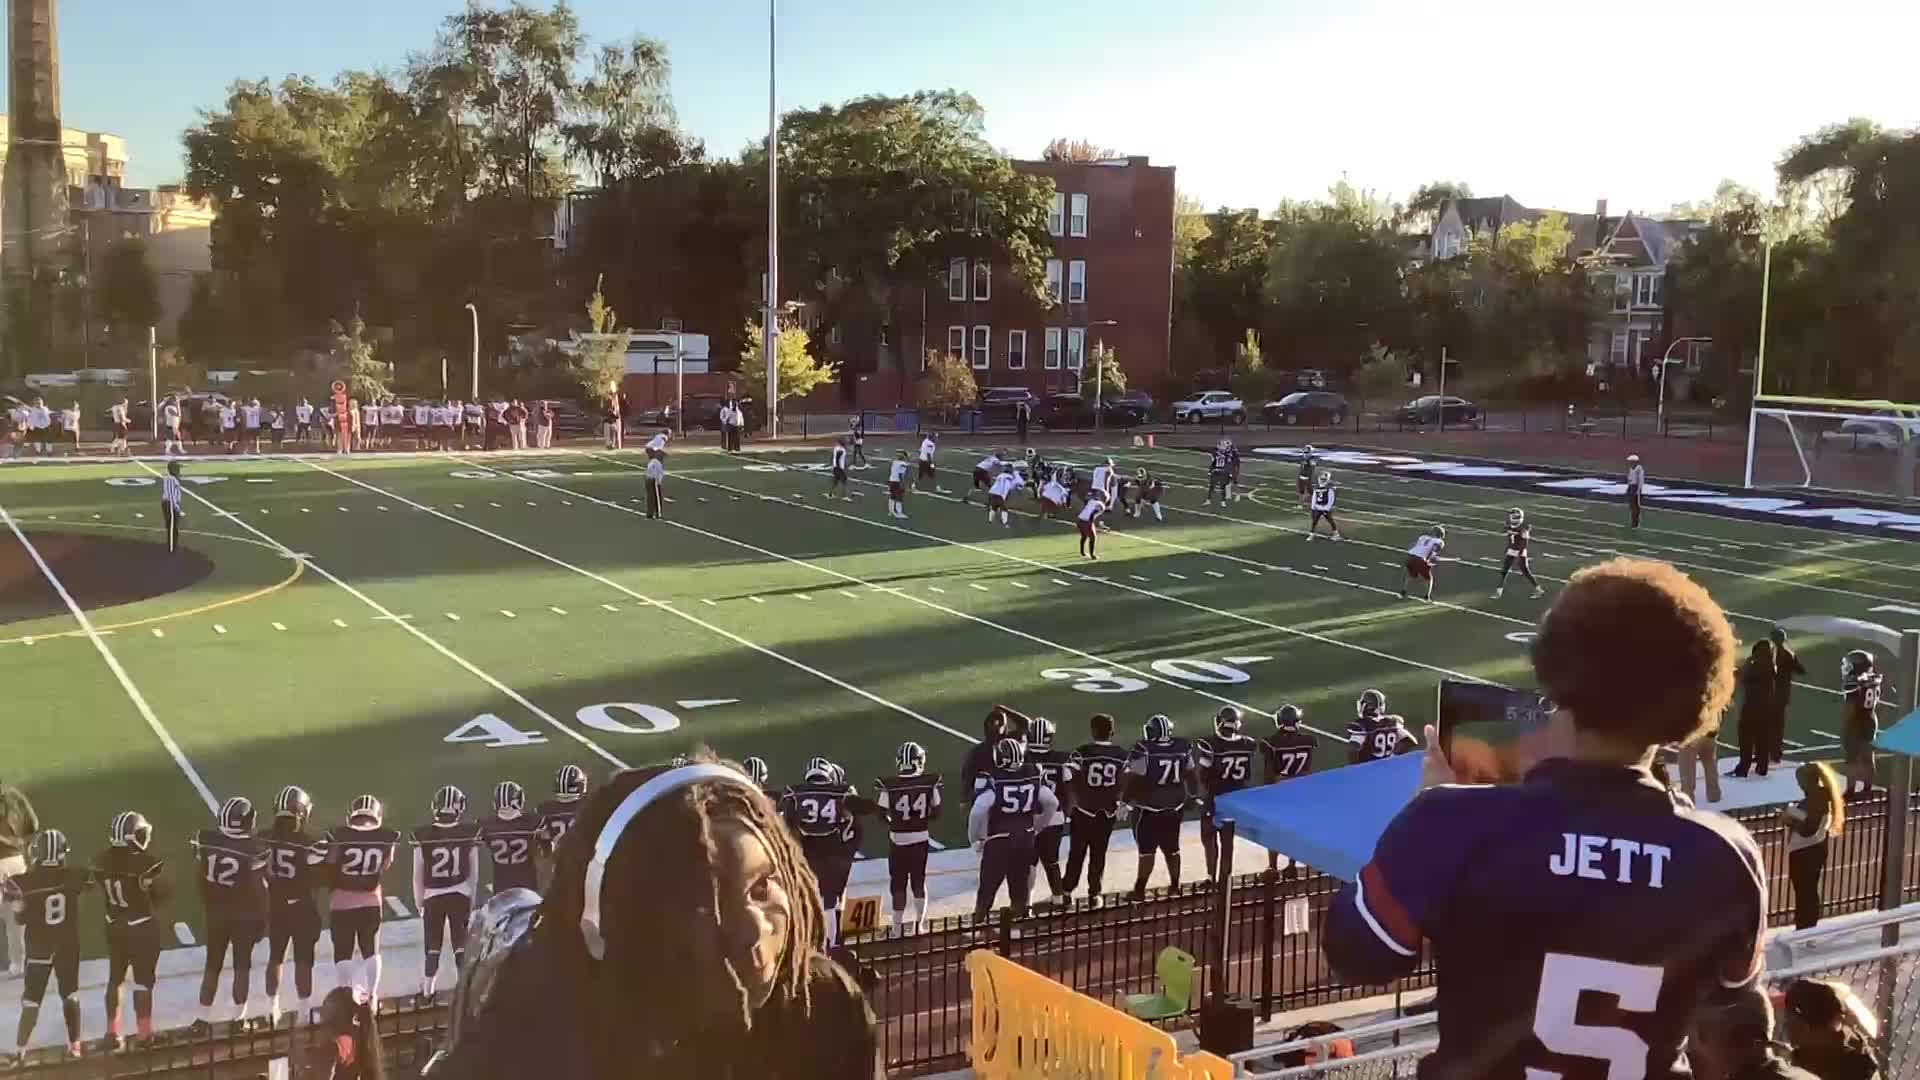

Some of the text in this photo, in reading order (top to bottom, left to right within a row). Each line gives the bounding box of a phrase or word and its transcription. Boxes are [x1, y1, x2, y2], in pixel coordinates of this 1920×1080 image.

[1039, 658, 1250, 693] 30
[443, 702, 681, 747] 40
[1371, 731, 1397, 757] 99
[1087, 763, 1116, 786] 69
[1158, 759, 1181, 784] 71
[1221, 757, 1246, 780] 75
[1281, 752, 1309, 775] 77
[800, 798, 837, 823] 34
[895, 794, 928, 818] 44
[1001, 784, 1035, 813] 57
[341, 847, 383, 875] 20
[431, 848, 461, 877] 21
[490, 838, 528, 864] 22
[1549, 833, 1671, 888] JETT
[206, 853, 240, 886] 12
[104, 878, 129, 907] 11
[45, 893, 66, 925] 8
[850, 899, 877, 928] 40
[1524, 952, 1665, 1080] 5
